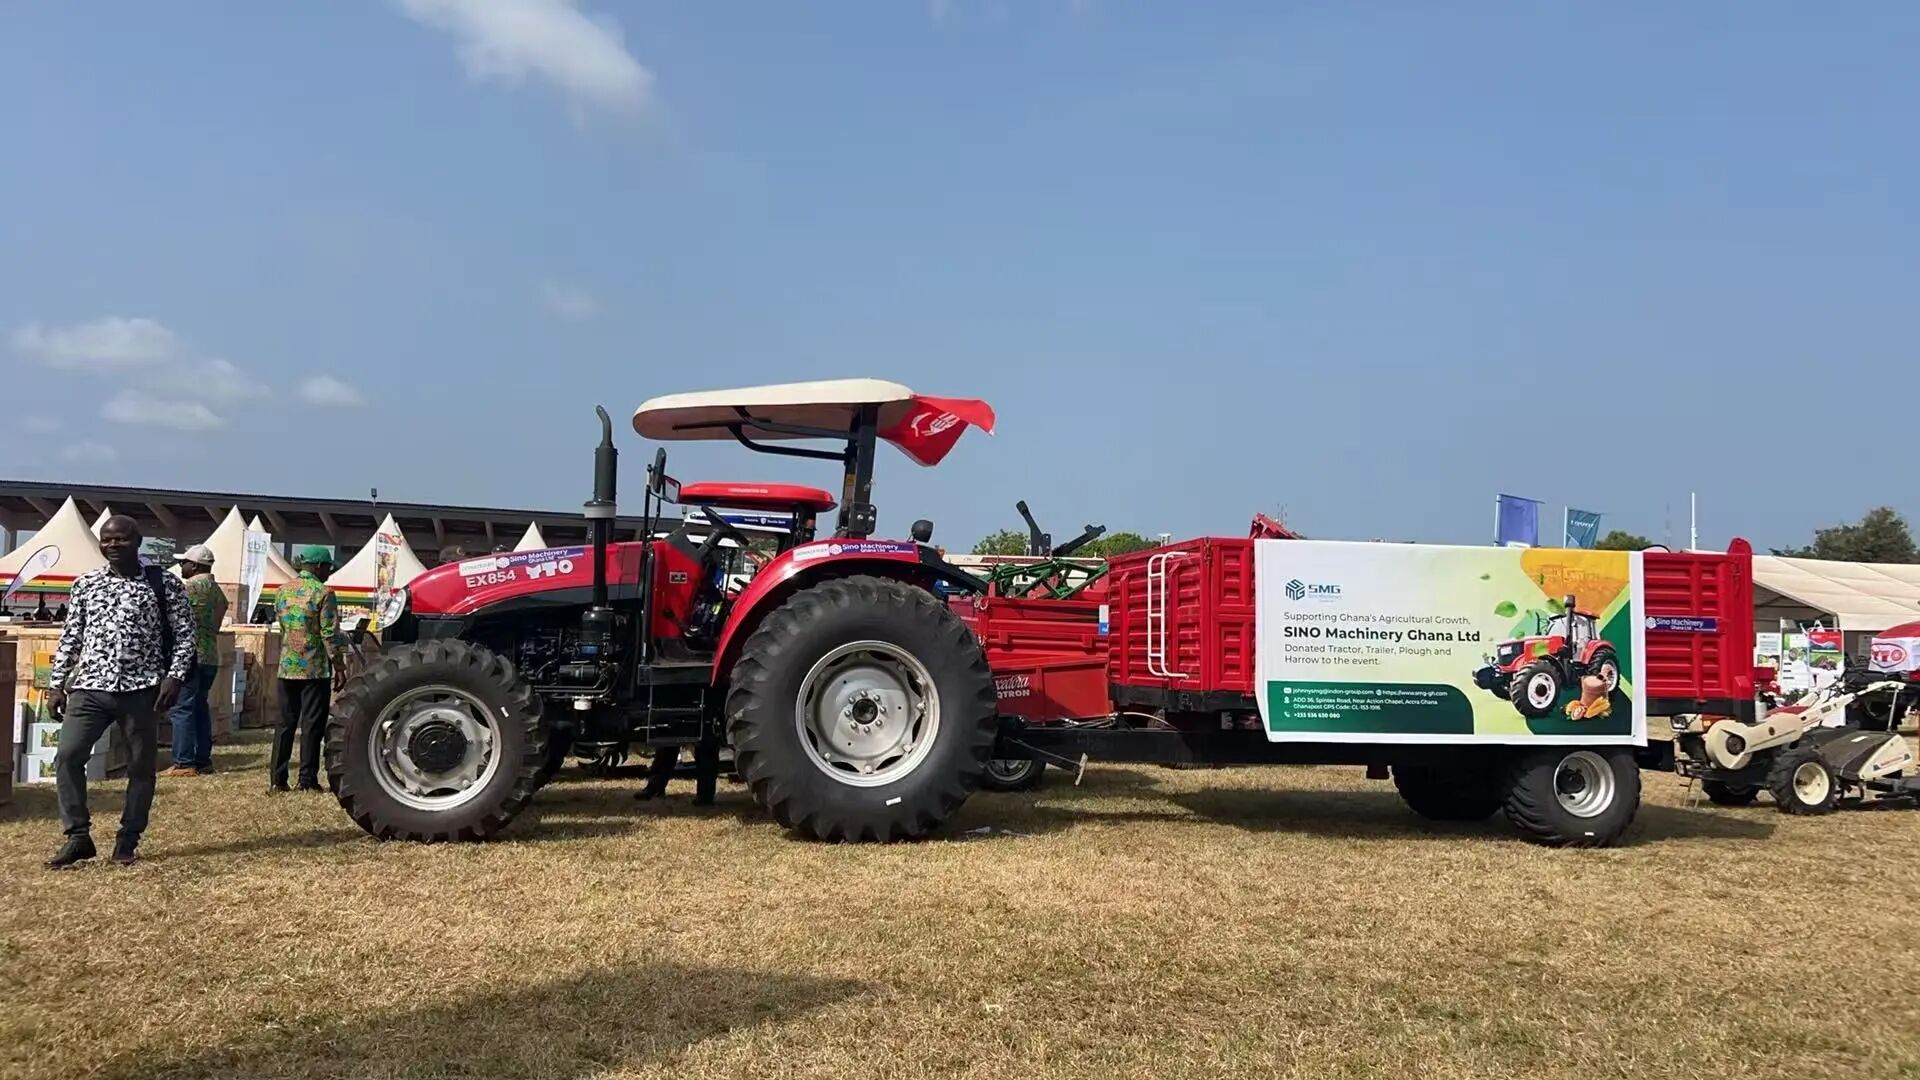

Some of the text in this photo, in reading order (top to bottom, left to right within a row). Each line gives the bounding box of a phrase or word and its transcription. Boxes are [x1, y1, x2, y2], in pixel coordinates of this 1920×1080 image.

[842, 543, 898, 551] Sino Machinery
[509, 553, 527, 563] Sino
[528, 549, 568, 560] Machinery
[526, 560, 574, 579] YTO
[466, 570, 516, 588] EX854
[1308, 584, 1341, 594] SMG
[1283, 611, 1471, 625] Supporting Ghana's Agricultural Growth,
[1656, 617, 1705, 629] Sino Machinery
[1283, 626, 1481, 643] SINO Machinery Ghana Ltd
[1284, 643, 1452, 657] Donated Tractor, Trailer, Plough and
[1284, 655, 1380, 666] Harrow to the event.
